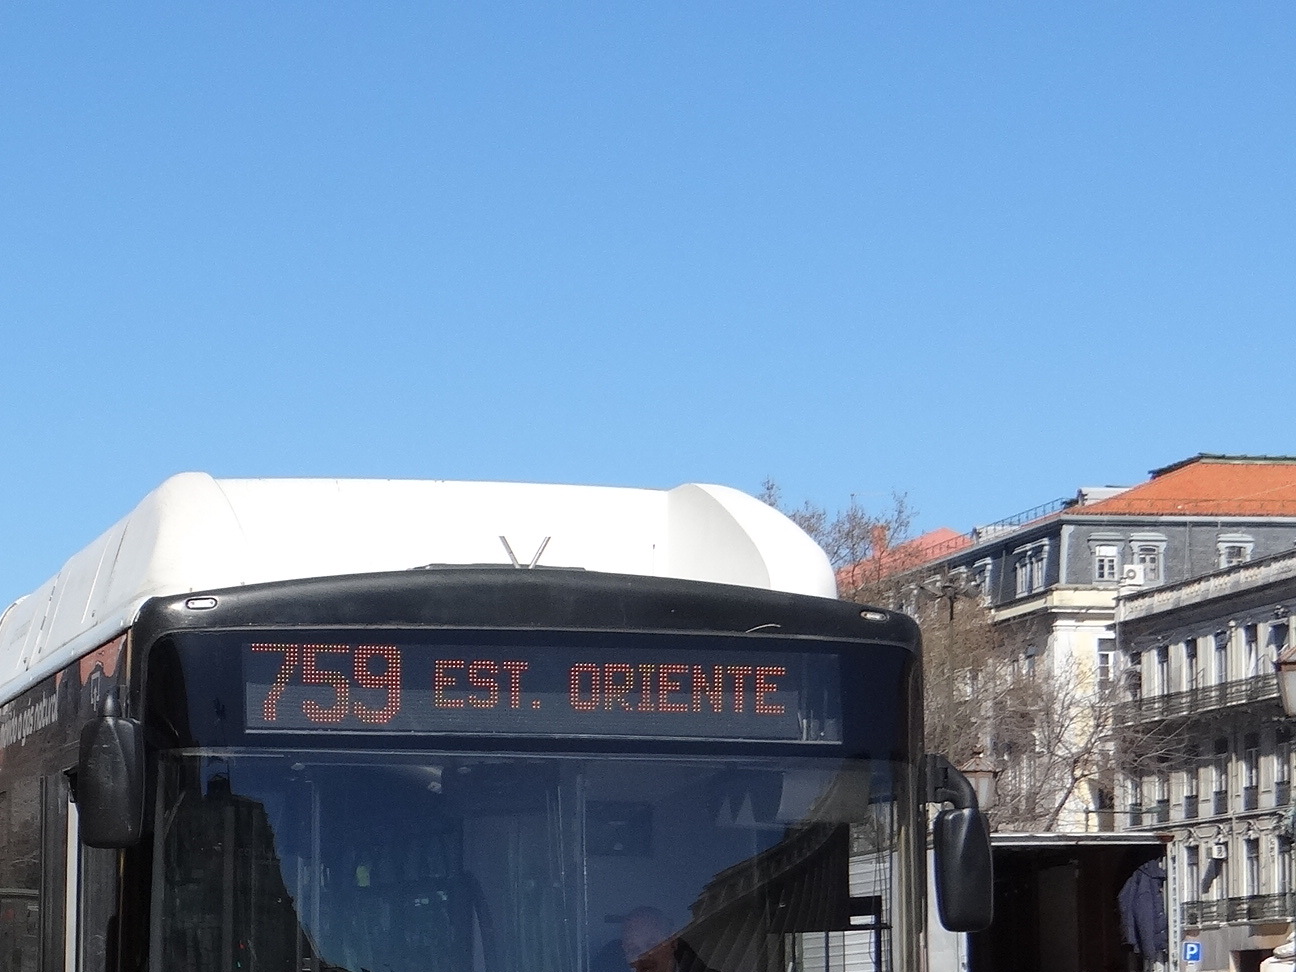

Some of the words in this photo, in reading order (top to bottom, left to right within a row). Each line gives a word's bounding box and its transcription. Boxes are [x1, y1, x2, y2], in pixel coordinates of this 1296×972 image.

[250, 642, 403, 724] 759
[433, 659, 542, 710] EST.
[569, 661, 788, 715] ORIENTE
